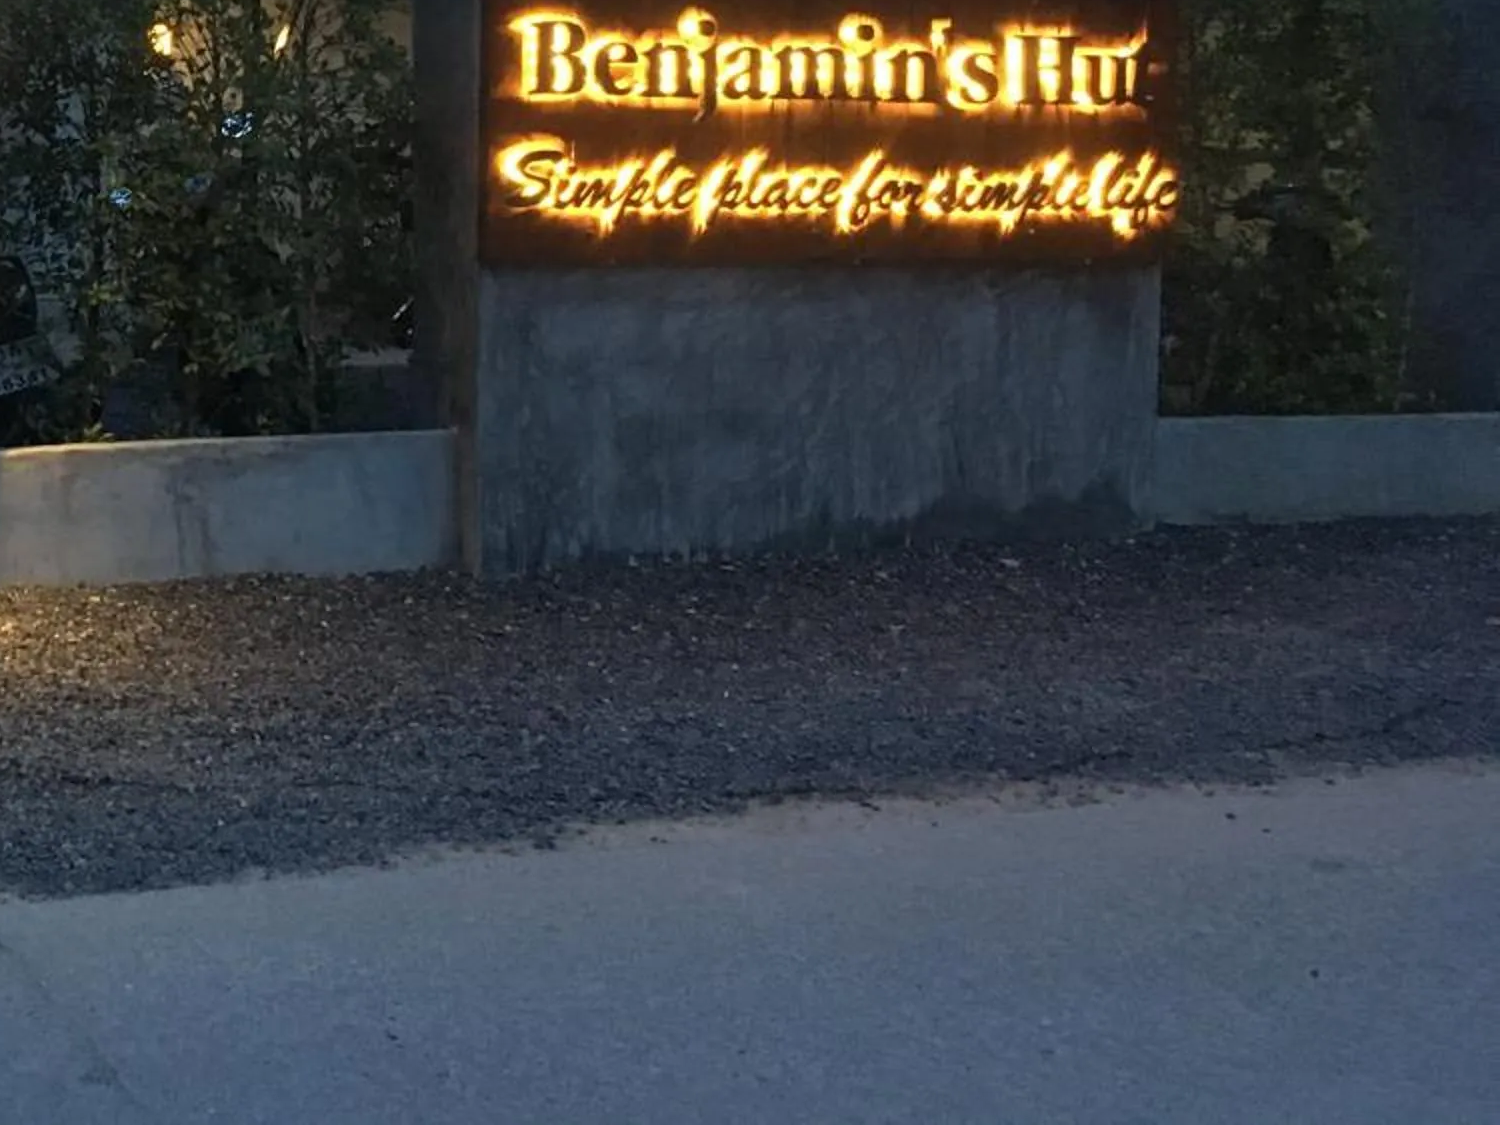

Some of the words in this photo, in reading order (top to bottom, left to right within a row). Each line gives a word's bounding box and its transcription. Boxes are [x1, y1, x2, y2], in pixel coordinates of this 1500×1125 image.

[522, 13, 998, 121] Benjamin's
[504, 148, 696, 224] Simple
[702, 151, 840, 231] place
[846, 153, 926, 227] for
[934, 154, 1092, 227] simple
[1097, 152, 1180, 226] life
